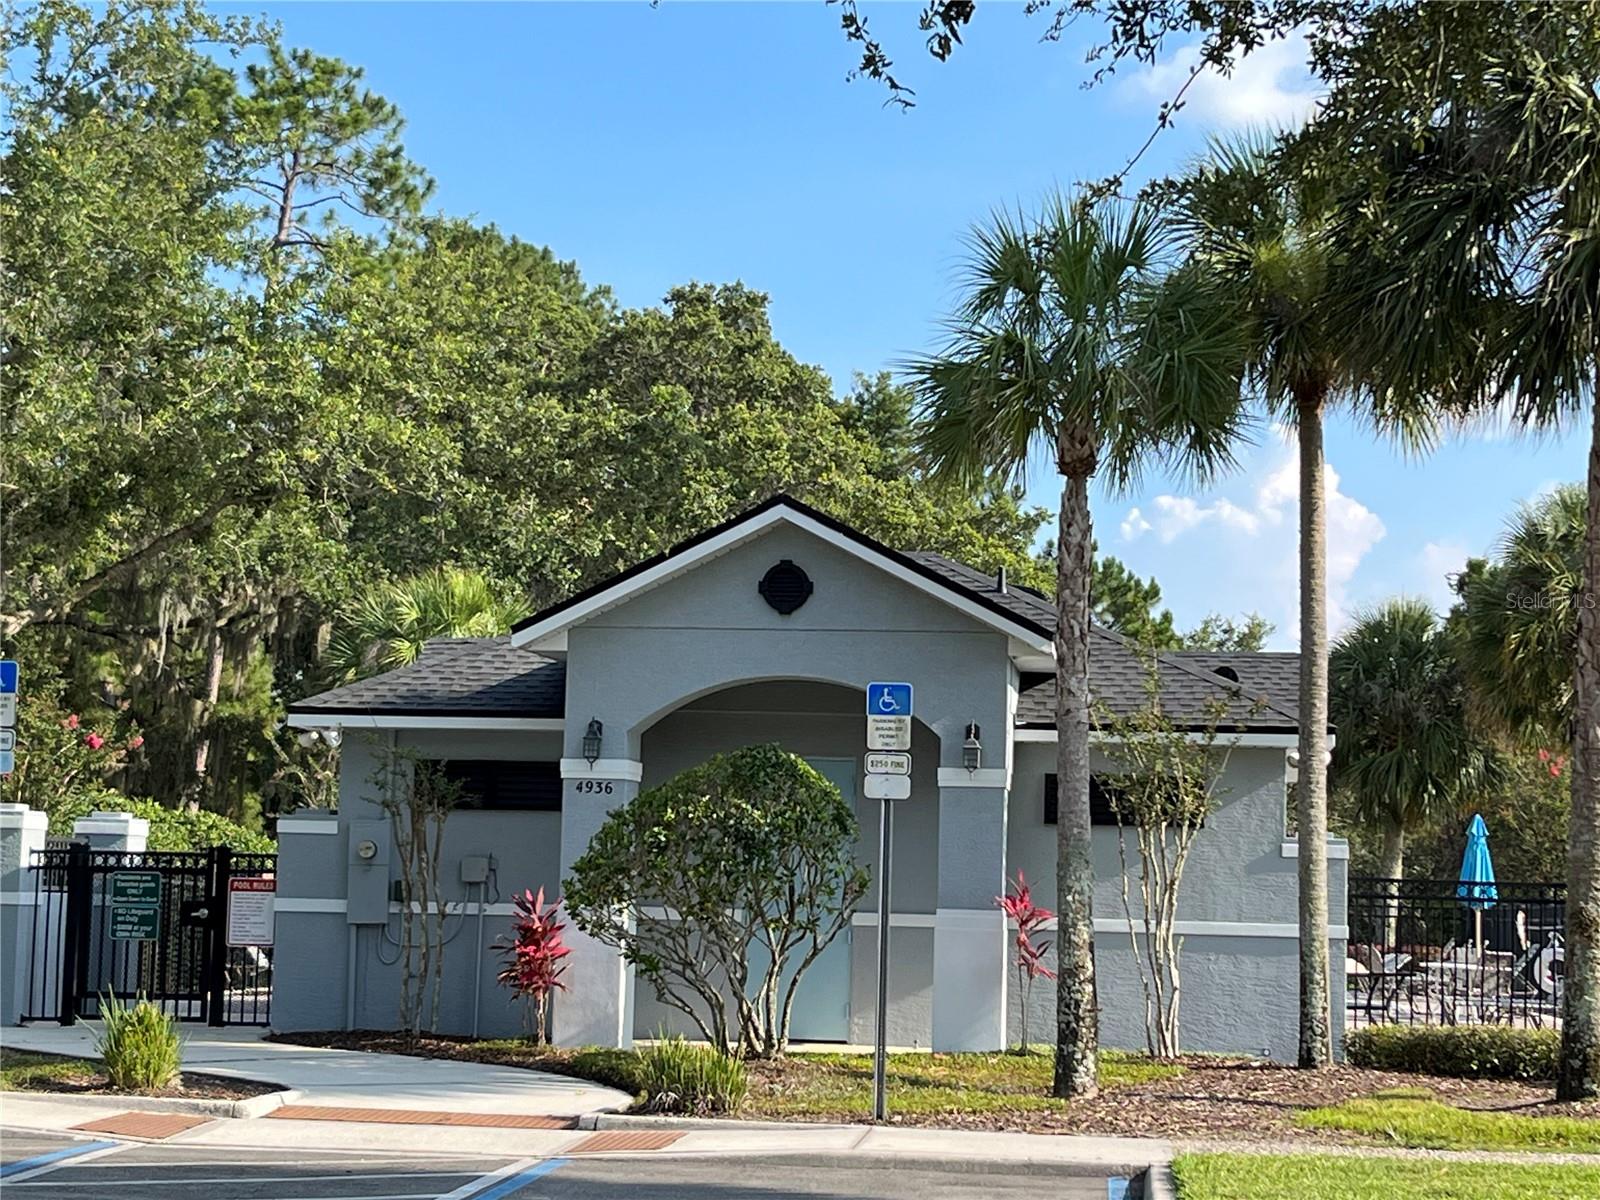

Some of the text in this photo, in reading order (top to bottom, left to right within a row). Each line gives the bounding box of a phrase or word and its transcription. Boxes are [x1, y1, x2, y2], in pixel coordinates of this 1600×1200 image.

[870, 759, 905, 769] $250 FINE
[575, 780, 613, 795] 4936
[233, 881, 274, 890] POOL RULES
